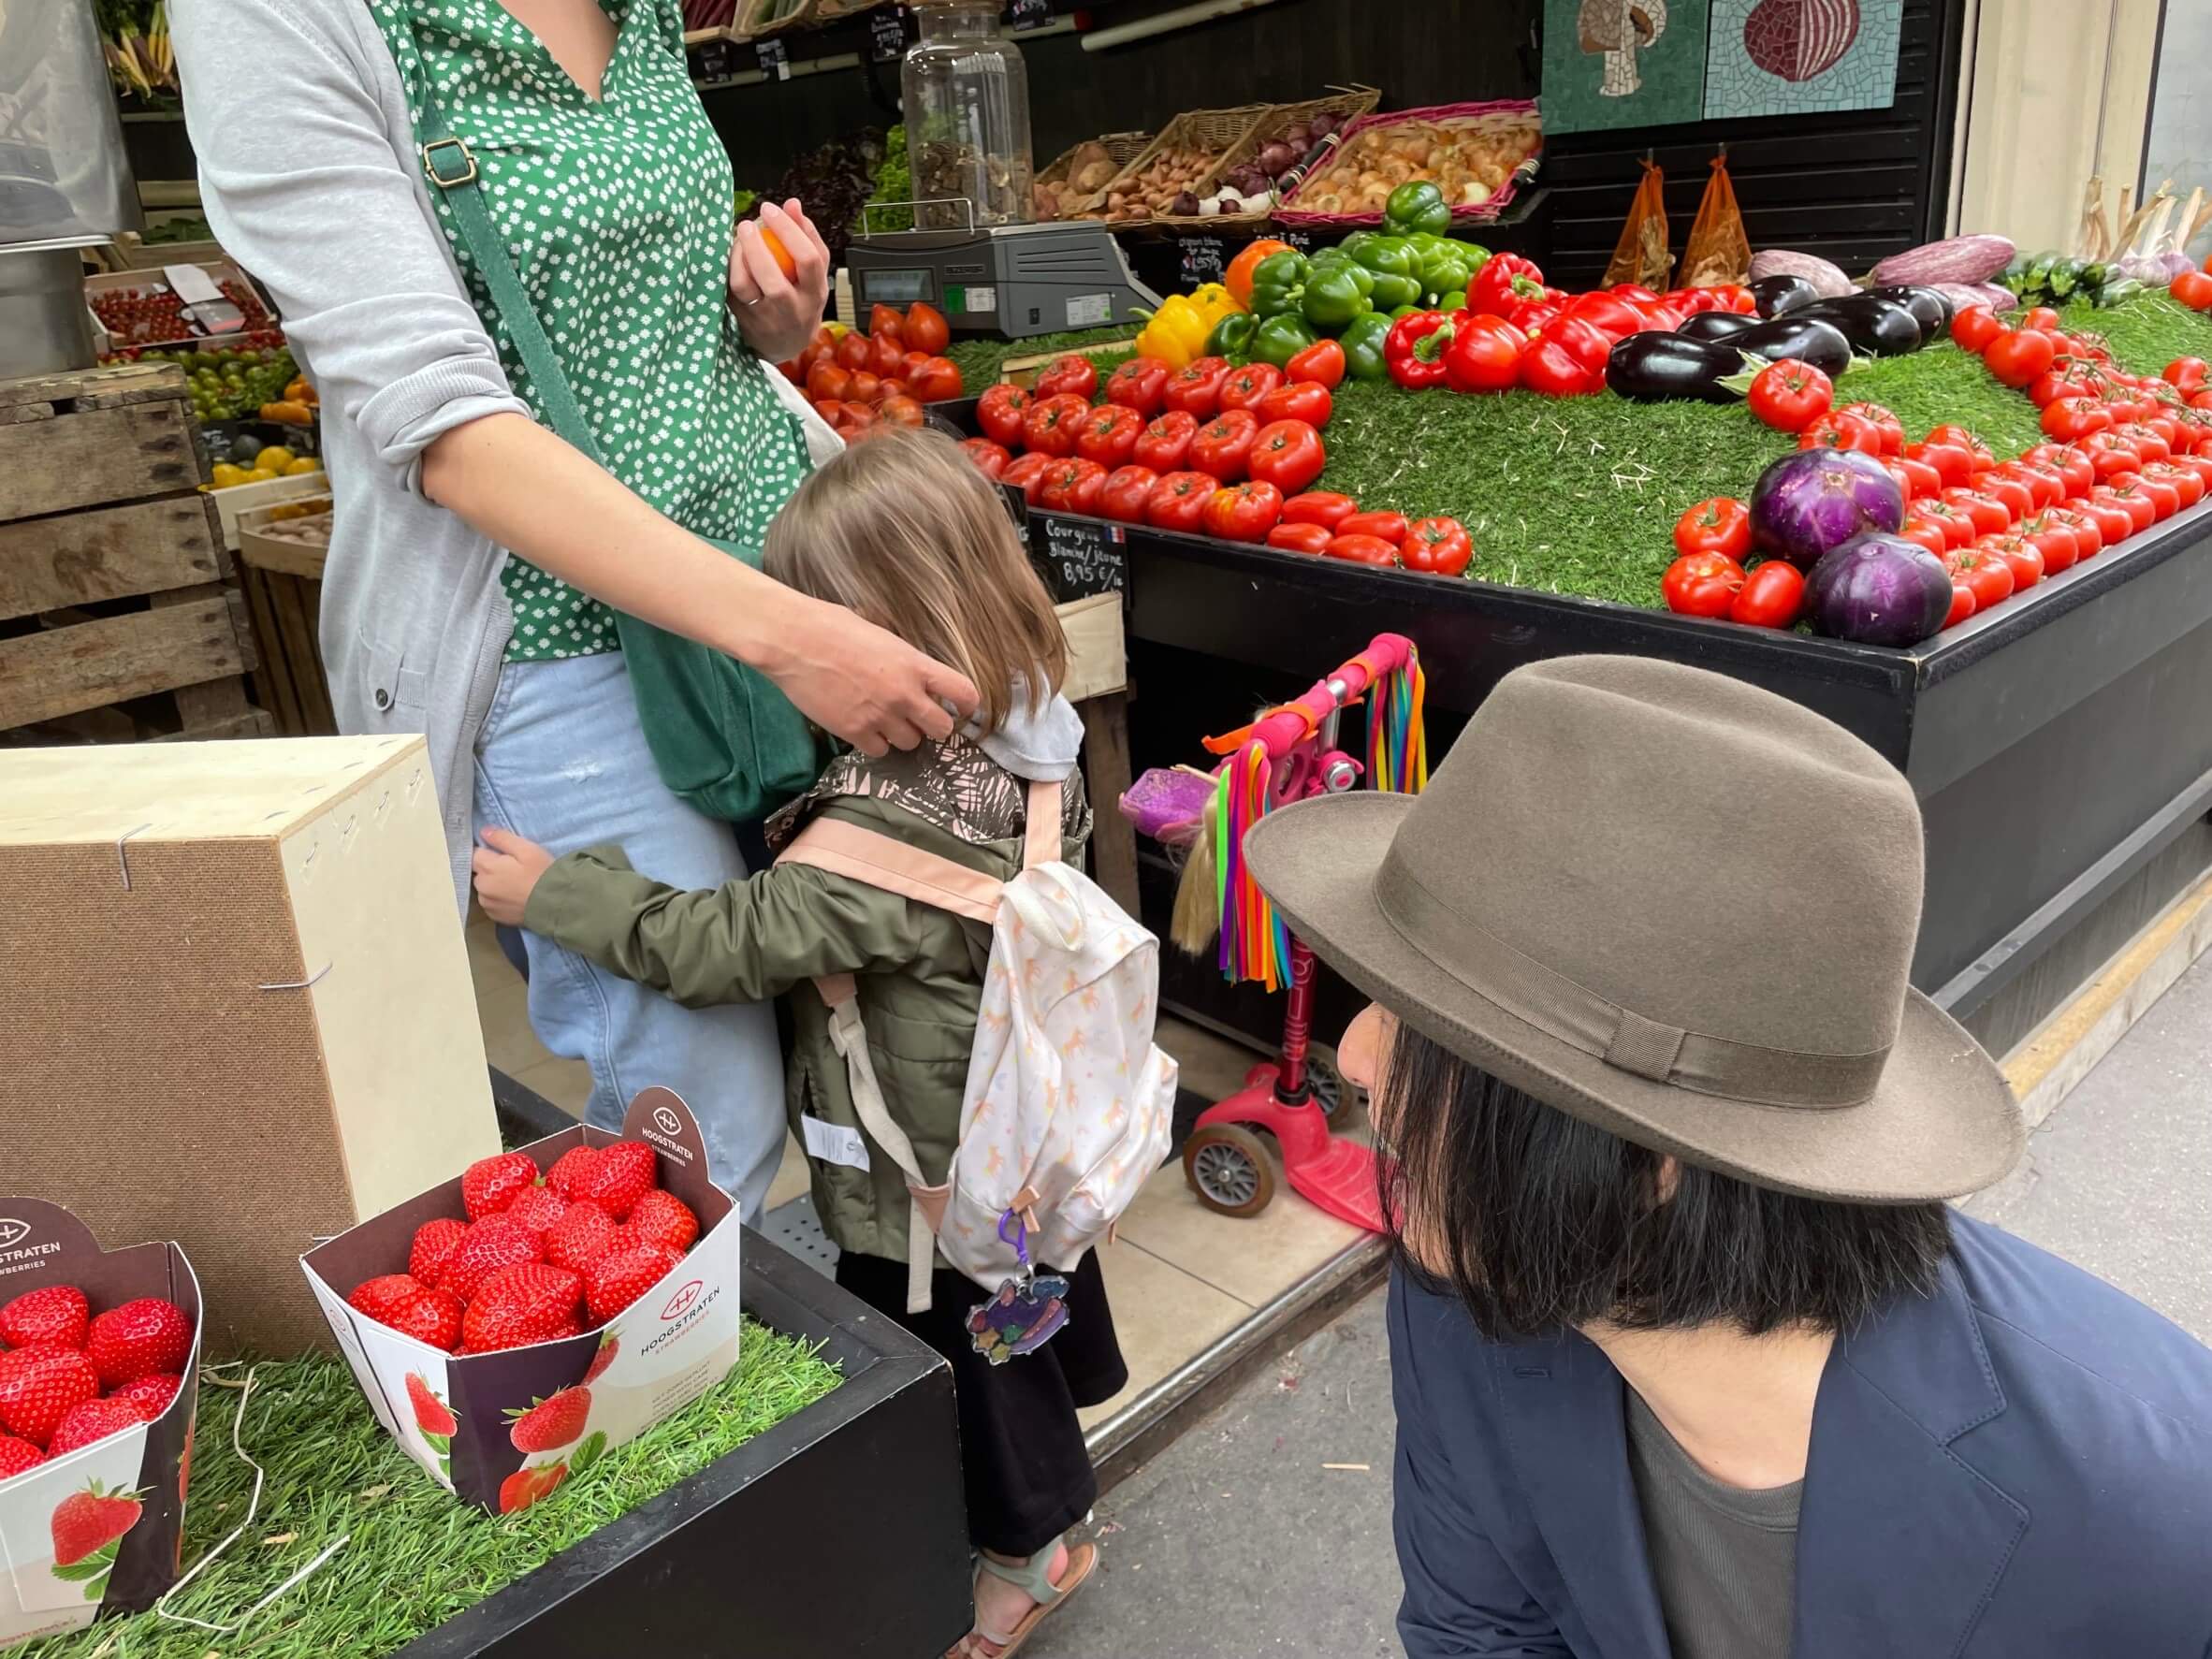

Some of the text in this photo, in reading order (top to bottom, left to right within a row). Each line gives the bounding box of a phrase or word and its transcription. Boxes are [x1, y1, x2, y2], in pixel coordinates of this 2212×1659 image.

[1063, 561, 1094, 586] 8,95
[642, 1127, 693, 1161] HOOGSTRATEN
[641, 1285, 720, 1357] HOOGSTRATEN
